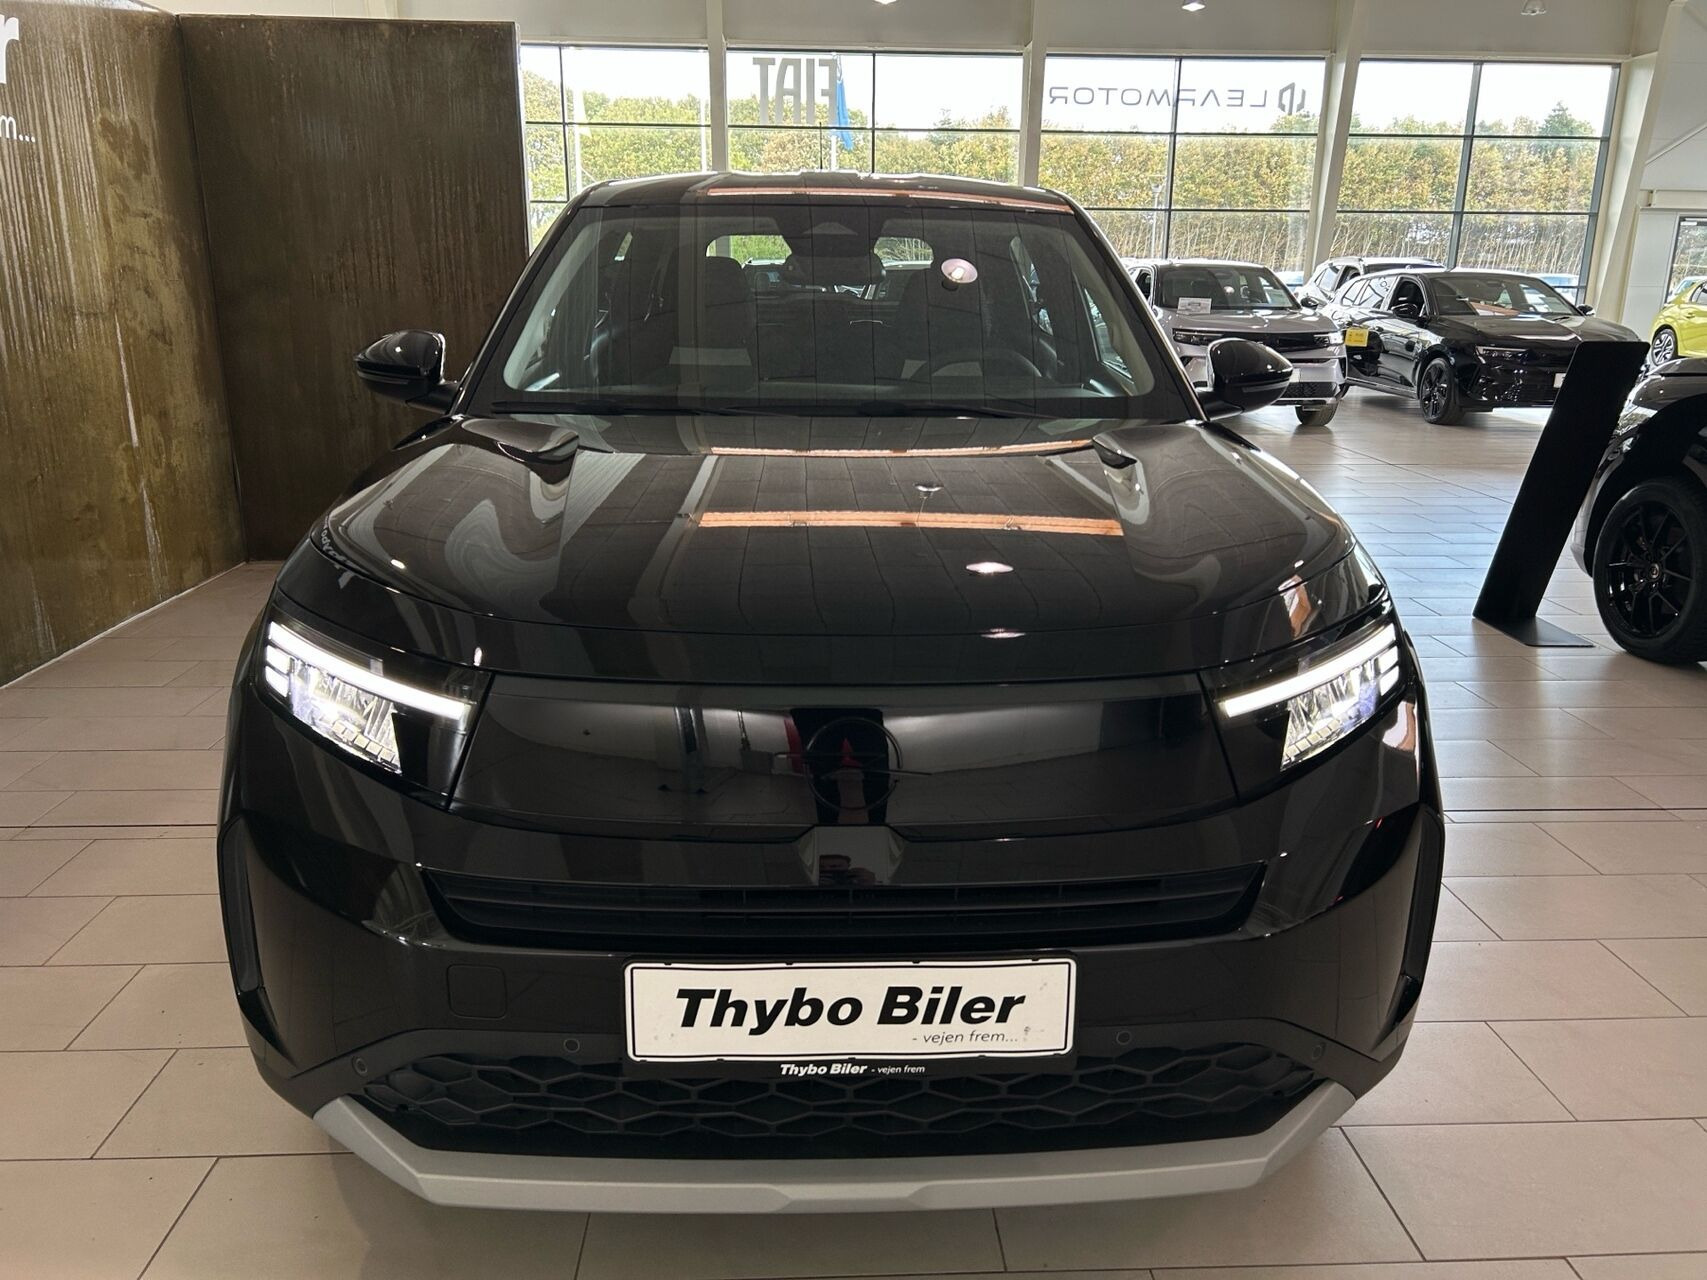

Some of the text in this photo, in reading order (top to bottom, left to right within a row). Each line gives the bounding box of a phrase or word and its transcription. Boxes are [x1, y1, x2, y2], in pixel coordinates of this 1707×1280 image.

[676, 986, 1026, 1035] Thybo Biler
[923, 1033, 964, 1046] vejen
[969, 1030, 1018, 1042] frem...
[780, 1064, 827, 1076] Thybo
[829, 1063, 867, 1075] Biler
[877, 1066, 901, 1075] vejen
[903, 1065, 925, 1073] frem
